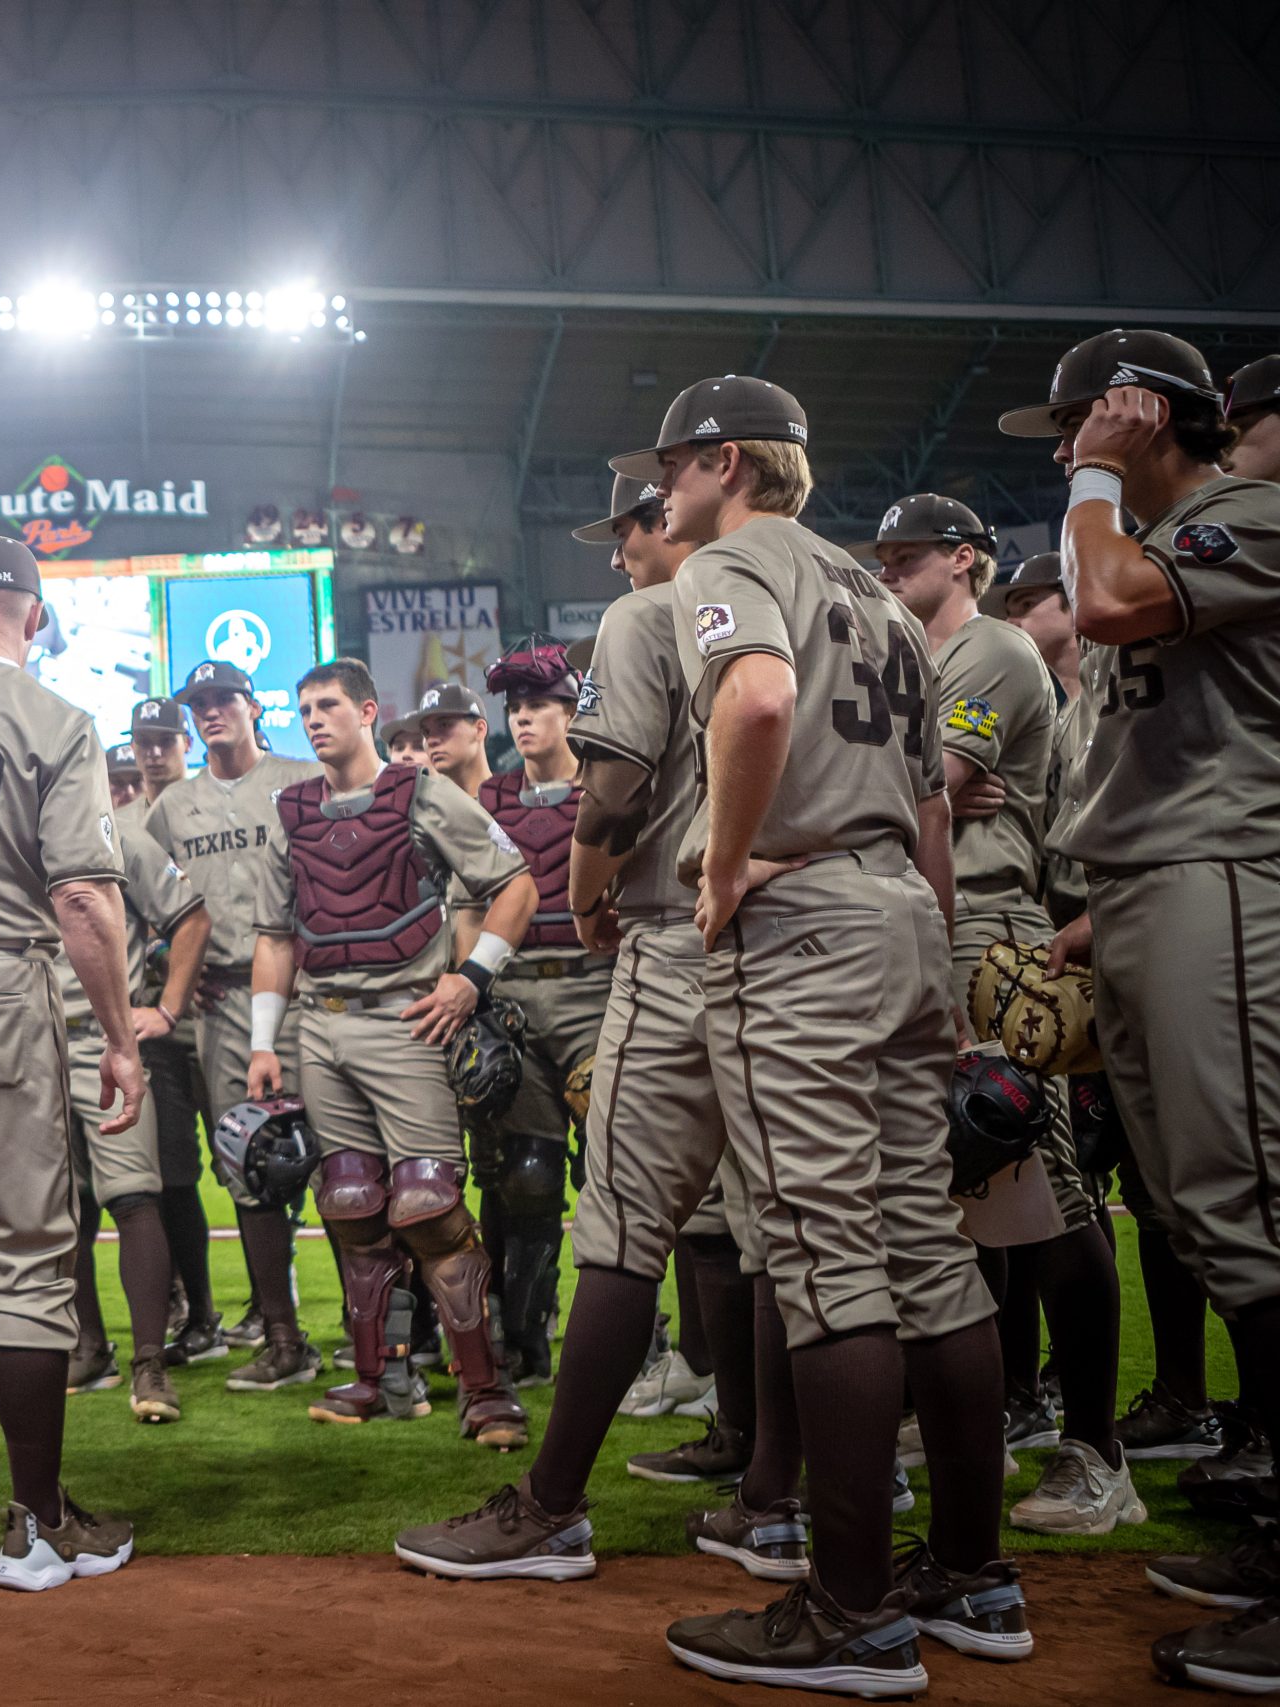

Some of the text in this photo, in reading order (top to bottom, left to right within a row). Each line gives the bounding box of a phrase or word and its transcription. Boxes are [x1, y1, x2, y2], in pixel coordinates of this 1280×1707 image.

[1109, 375, 1139, 385] adidas
[696, 426, 721, 435] adidas
[86, 479, 208, 515] Maid
[22, 519, 93, 554] Park
[370, 586, 476, 611] VIVE TU
[370, 608, 493, 633] ESTRELLA
[827, 601, 926, 760] 34
[183, 828, 248, 859] TEXAS
[987, 1068, 1031, 1115] Wilson
